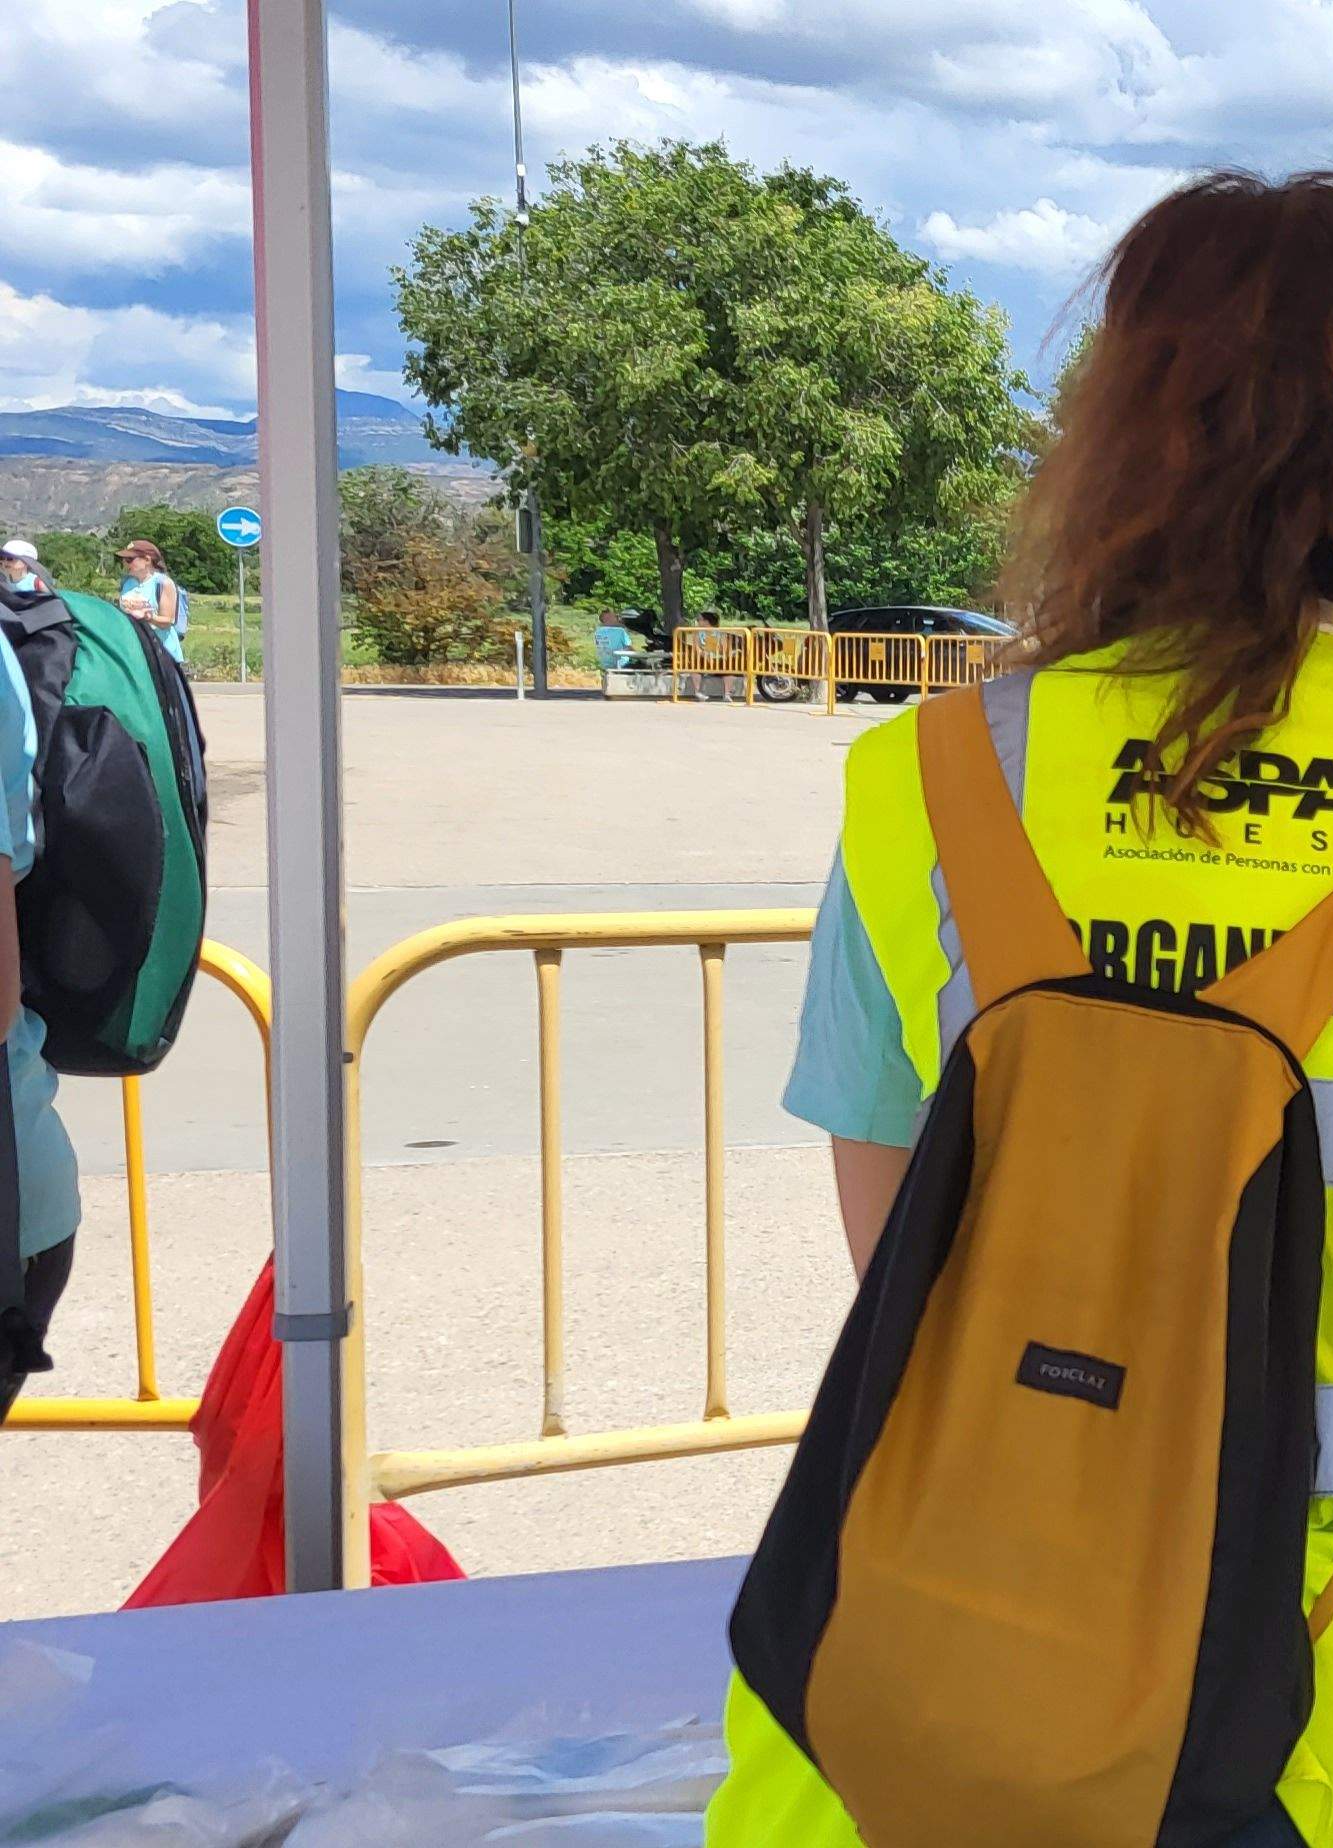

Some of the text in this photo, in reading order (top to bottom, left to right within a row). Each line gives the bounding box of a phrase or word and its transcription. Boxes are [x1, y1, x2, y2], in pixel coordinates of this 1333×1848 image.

[1103, 845, 1195, 864] Asociación
[1200, 850, 1221, 866] de
[1226, 852, 1298, 874] Personas
[1302, 861, 1331, 877] con
